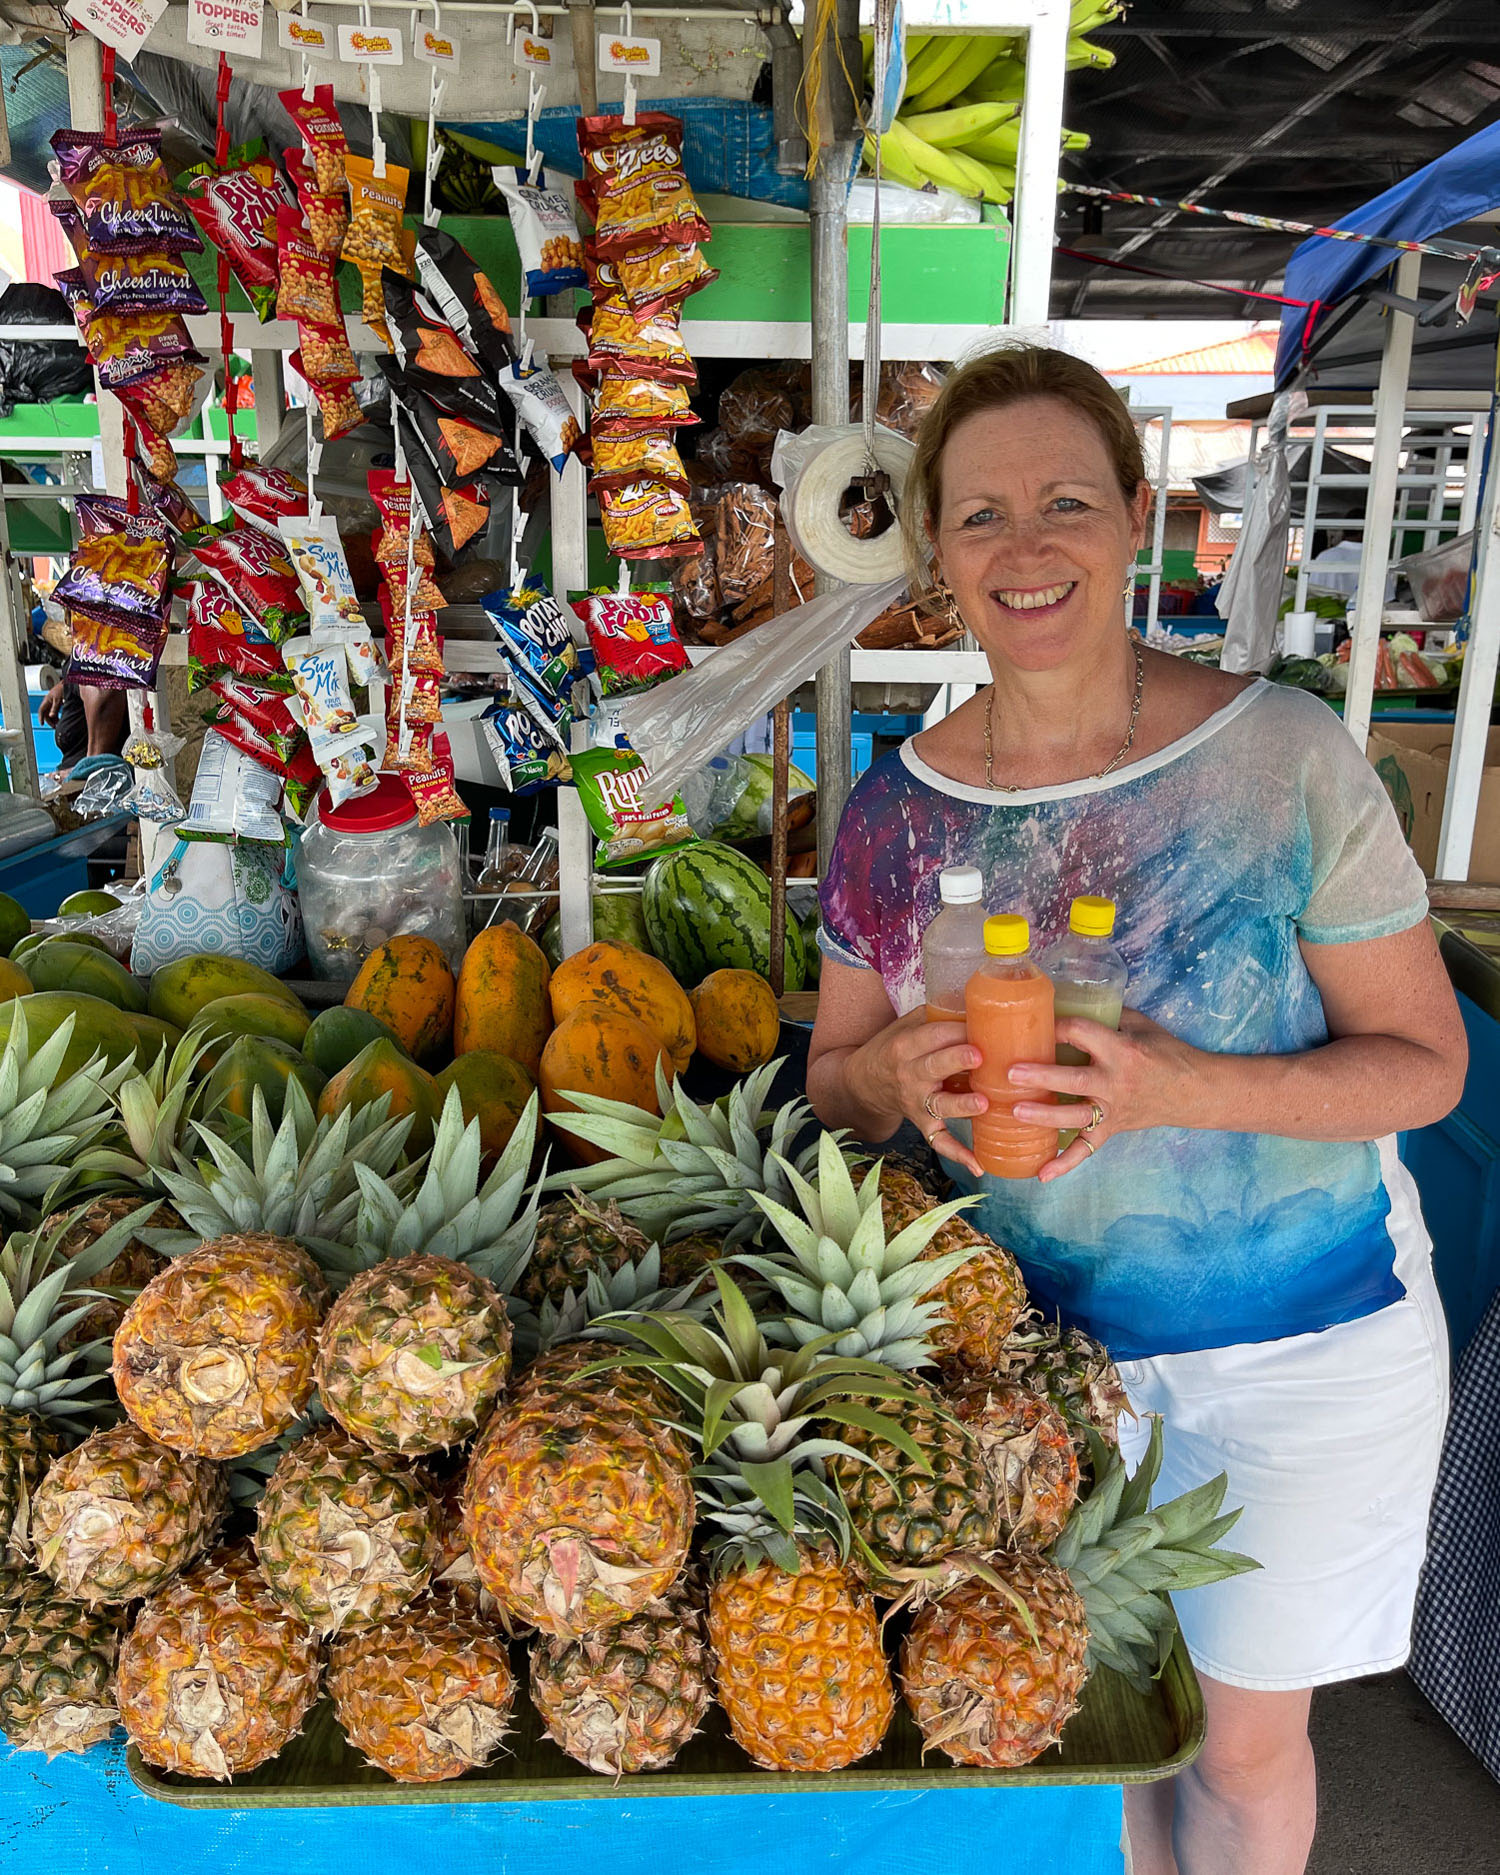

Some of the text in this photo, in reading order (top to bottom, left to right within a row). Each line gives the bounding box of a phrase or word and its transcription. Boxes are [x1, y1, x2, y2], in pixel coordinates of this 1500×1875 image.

[194, 0, 259, 27] TOPPERS
[306, 121, 343, 135] Peanuts
[361, 186, 403, 210] Peanuts
[287, 241, 330, 262] Peanuts
[418, 257, 432, 269] 220
[100, 269, 192, 293] CheeseTwist
[382, 500, 411, 511] Peanu
[307, 544, 339, 563] Sun
[327, 560, 351, 583] Mix
[600, 603, 664, 636] FOOT
[72, 642, 154, 672] CheeseTwist
[300, 655, 335, 681] Sun
[313, 671, 341, 698] Mix
[408, 766, 448, 787] Peanuts
